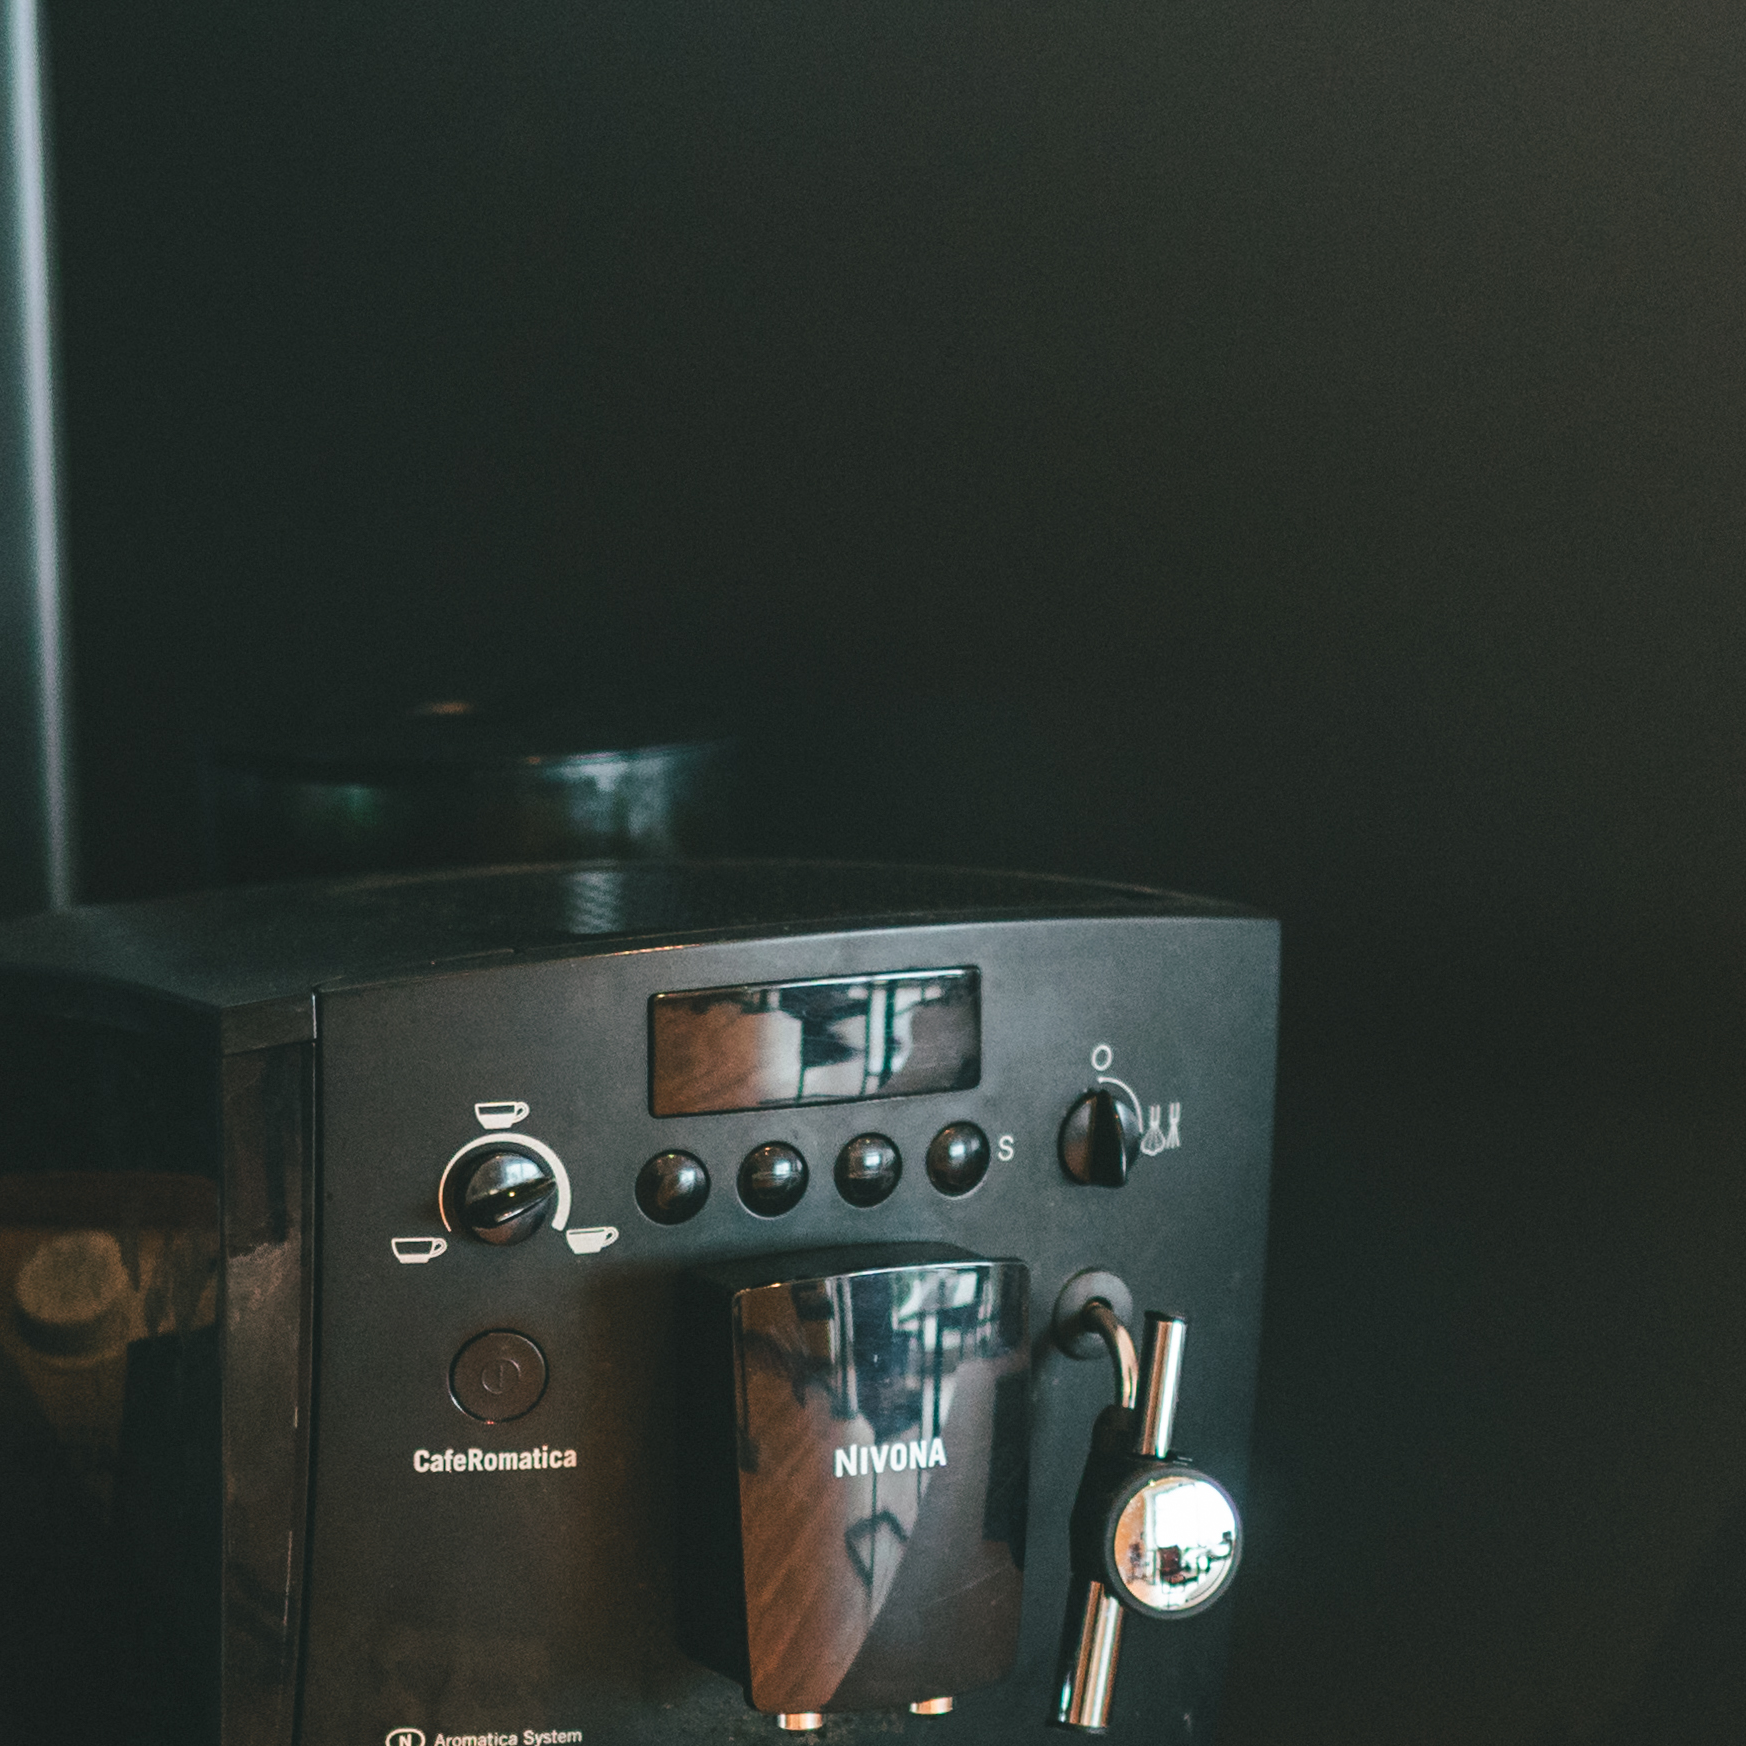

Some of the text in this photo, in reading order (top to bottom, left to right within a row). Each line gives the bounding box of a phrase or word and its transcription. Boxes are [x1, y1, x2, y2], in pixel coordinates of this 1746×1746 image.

[998, 1135, 1014, 1161] S
[412, 1445, 578, 1474] CafeRomatica
[834, 1437, 947, 1478] NIVONA
